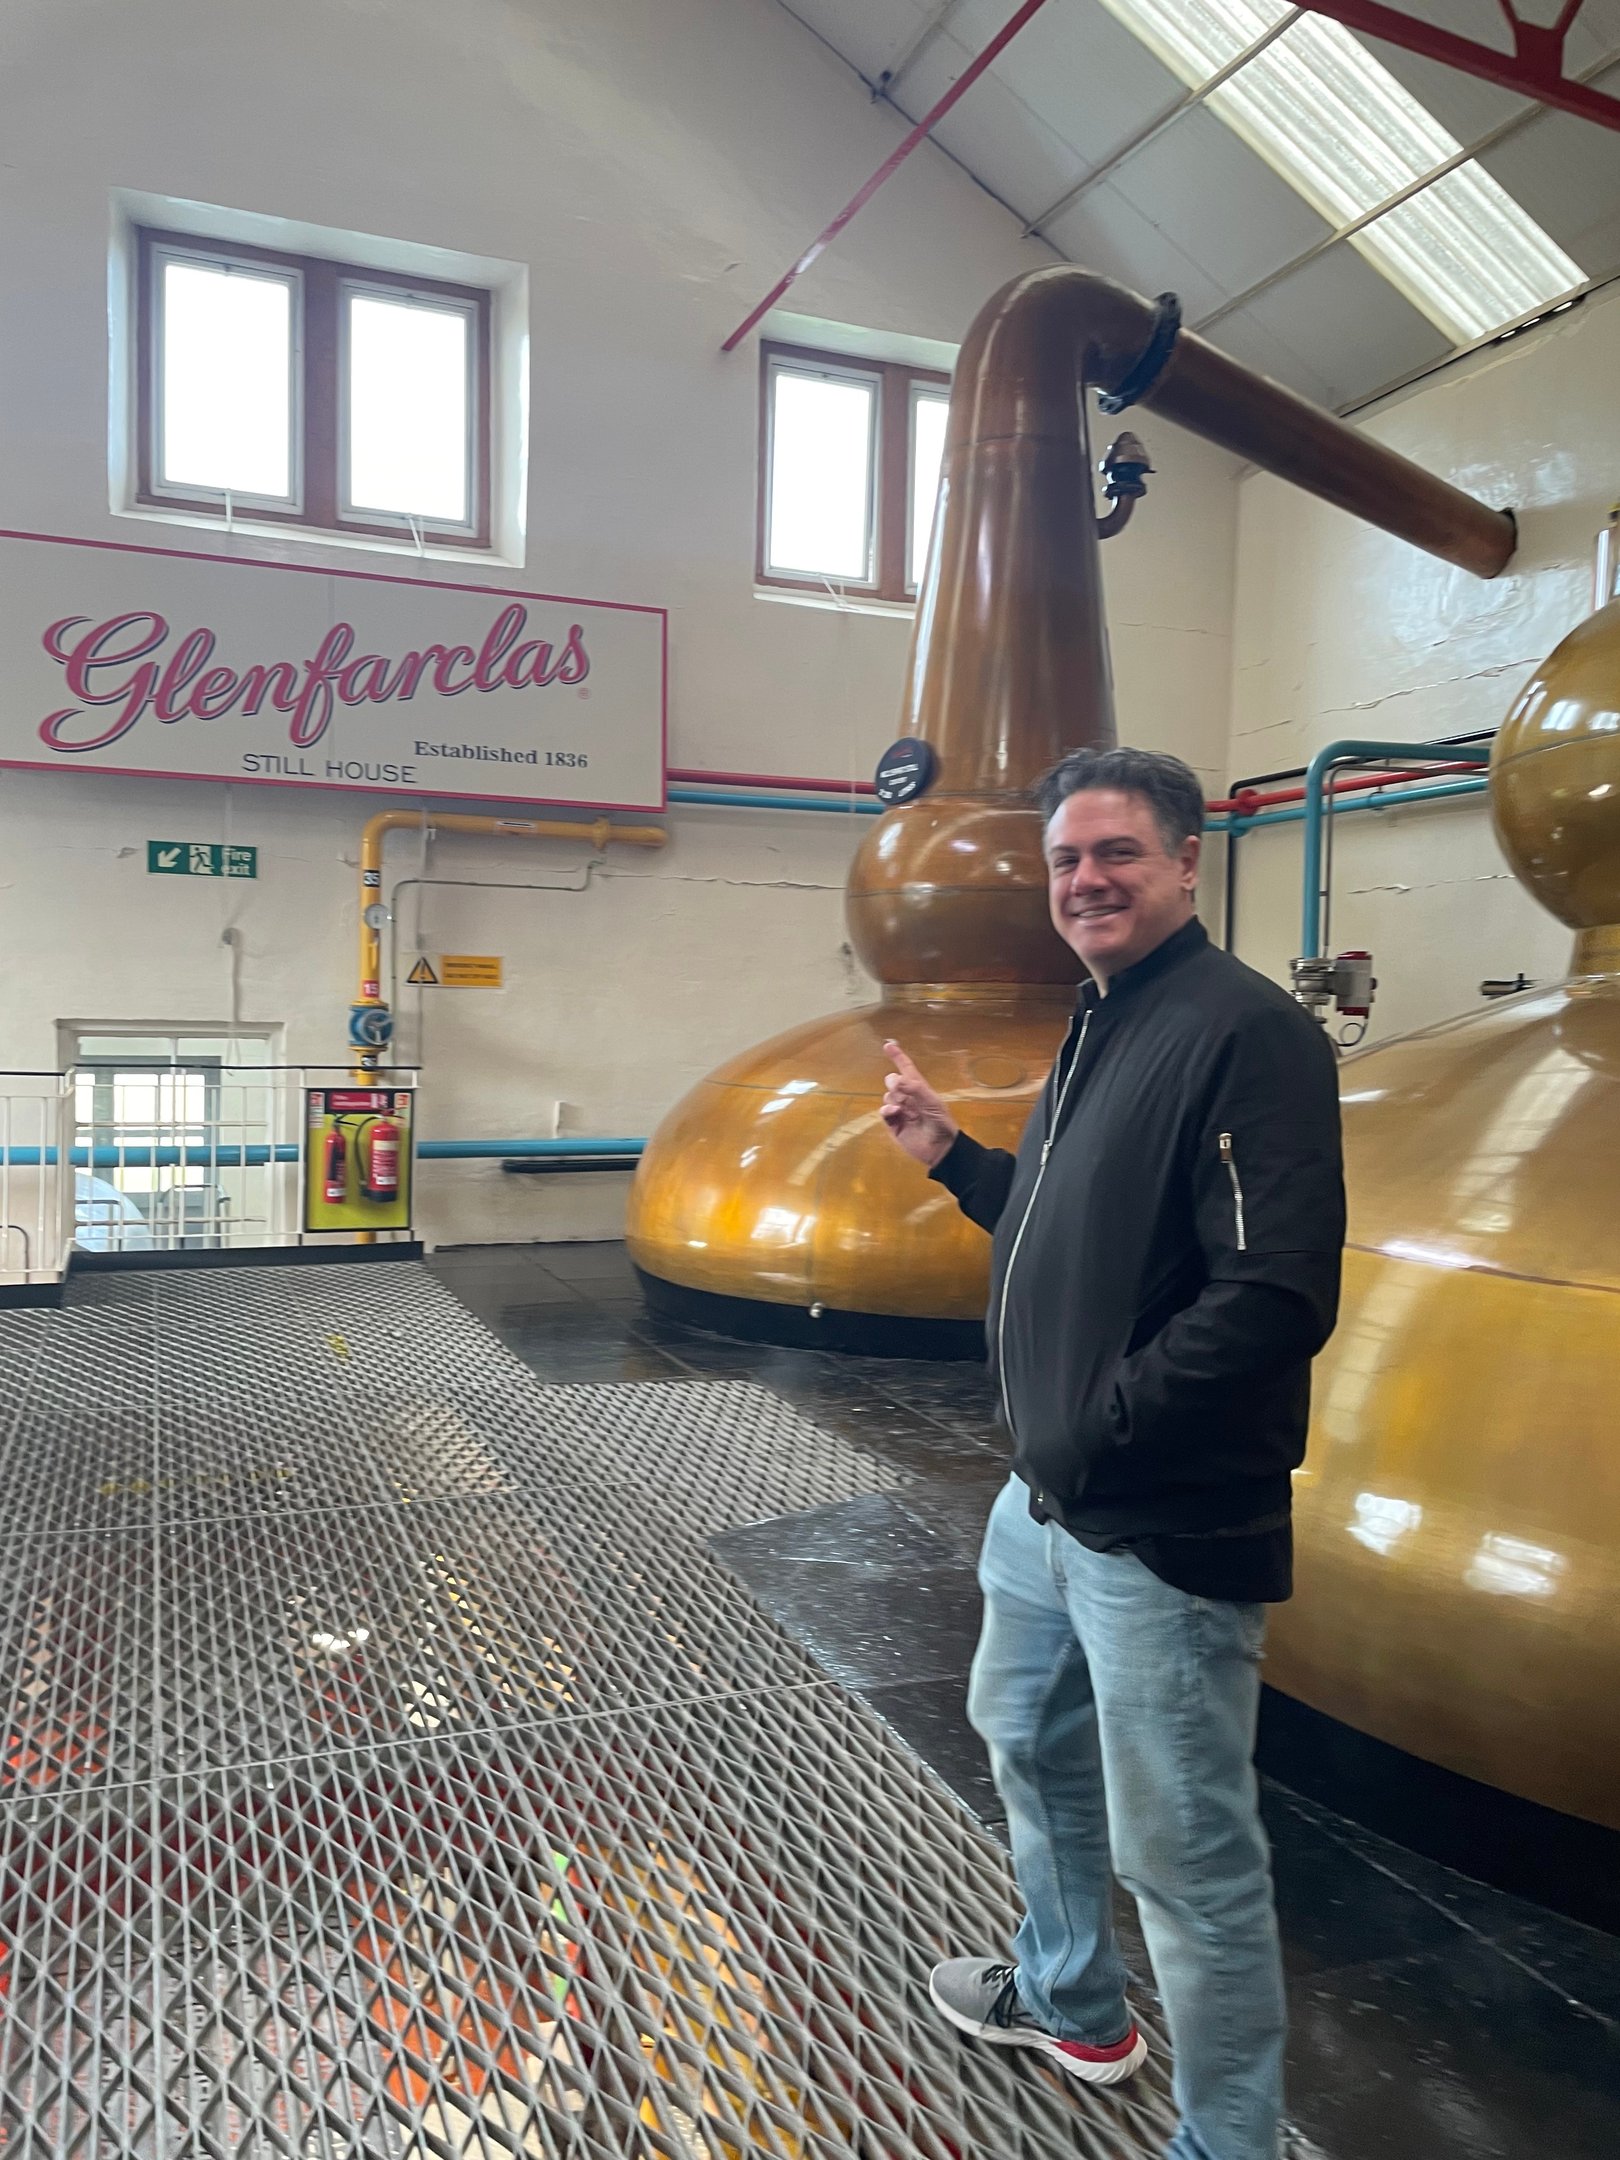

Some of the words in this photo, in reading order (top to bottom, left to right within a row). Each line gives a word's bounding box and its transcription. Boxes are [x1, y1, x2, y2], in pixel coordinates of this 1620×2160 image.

[38, 603, 591, 752] Glenfarclas
[242, 753, 315, 776] STILL
[325, 760, 418, 783] HOUSE
[414, 741, 538, 764] Established
[545, 752, 588, 768] 1836
